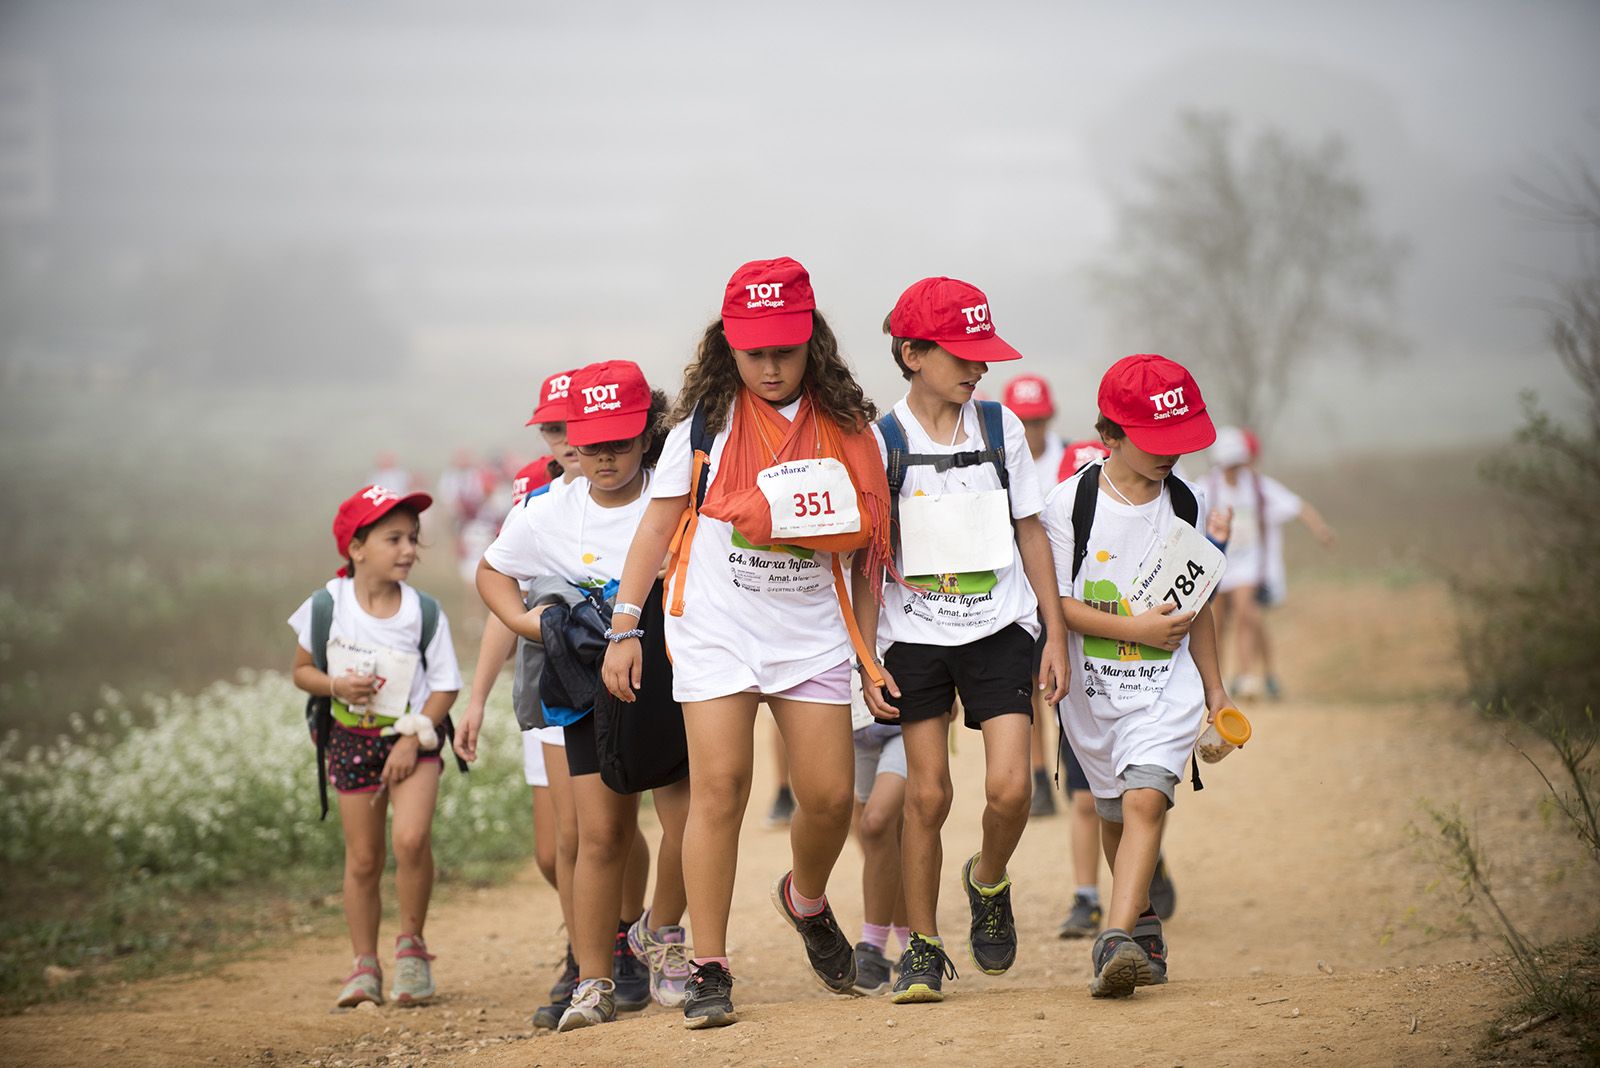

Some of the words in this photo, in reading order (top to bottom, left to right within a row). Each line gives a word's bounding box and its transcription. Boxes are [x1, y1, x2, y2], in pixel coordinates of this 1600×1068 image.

[746, 283, 783, 300] TOT
[550, 375, 571, 393] TO
[581, 383, 619, 404] TOT
[1149, 387, 1185, 411] TOT
[793, 491, 835, 517] 351
[748, 556, 786, 569] Marxa
[1163, 560, 1205, 610] 784
[919, 592, 956, 603] Marxa
[1100, 665, 1137, 678] Marxa
